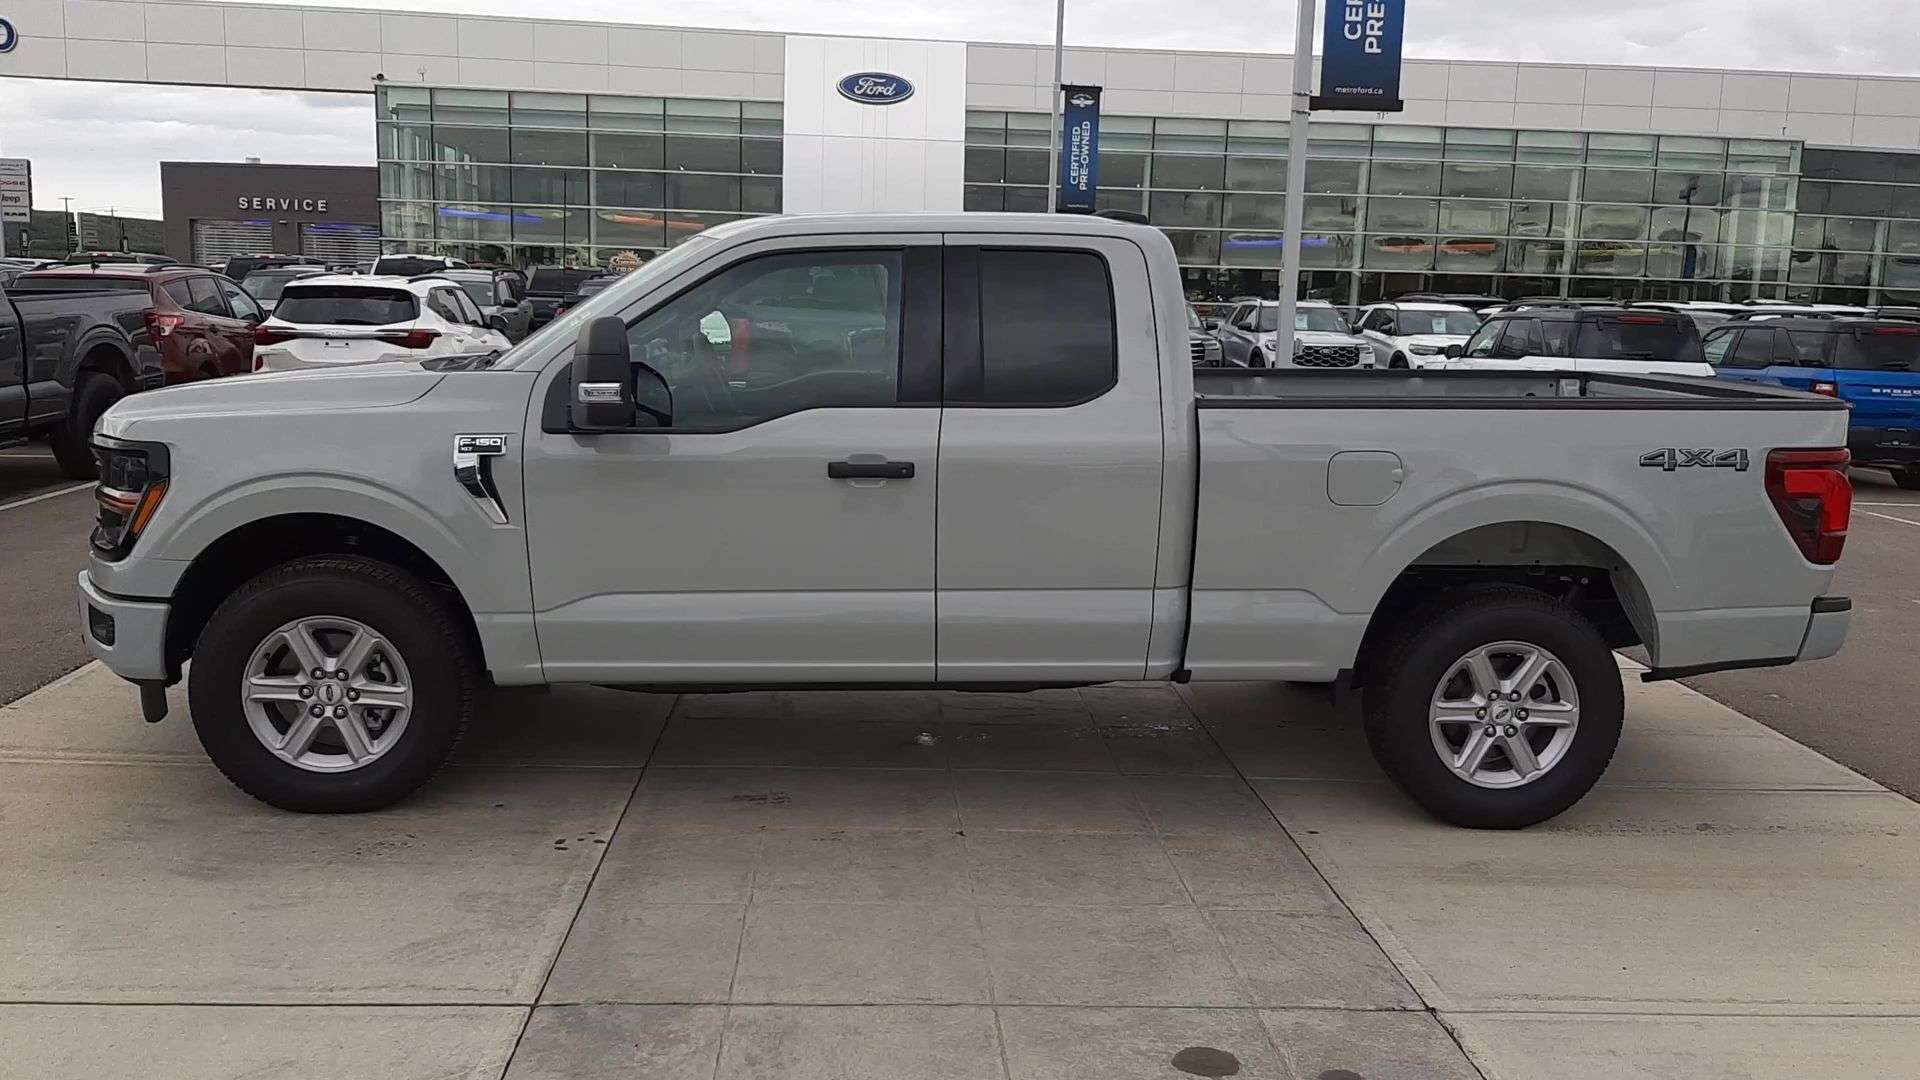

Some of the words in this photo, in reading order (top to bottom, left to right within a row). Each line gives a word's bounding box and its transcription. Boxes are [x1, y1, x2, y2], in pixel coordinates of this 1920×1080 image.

[1070, 126, 1081, 185] CERTIFIED
[1079, 121, 1091, 191] PRE-OWNED
[238, 196, 328, 212] SERVICE
[460, 438, 502, 446] F-150
